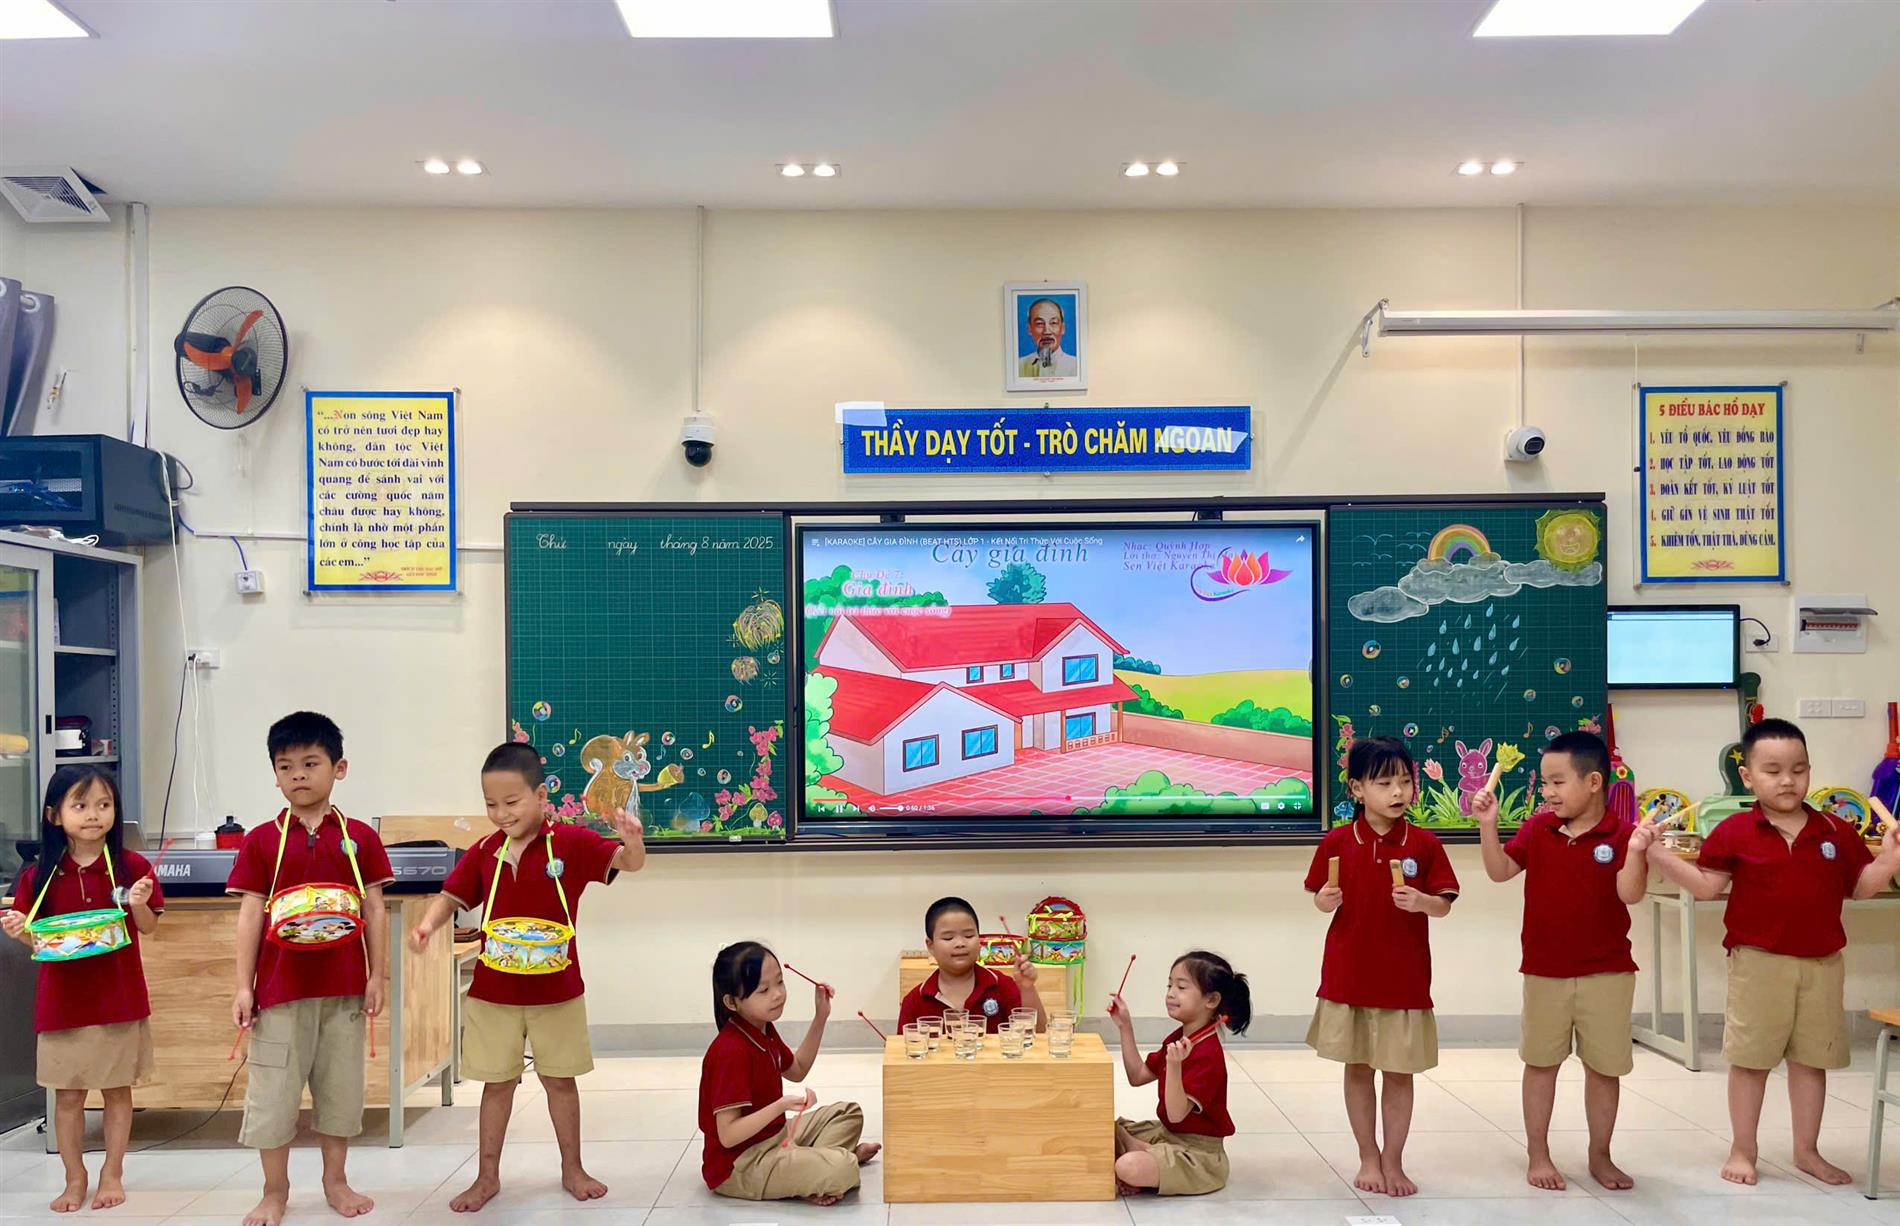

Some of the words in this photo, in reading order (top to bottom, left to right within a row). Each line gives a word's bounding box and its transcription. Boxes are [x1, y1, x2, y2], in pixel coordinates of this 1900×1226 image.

[1659, 404, 1665, 416] 5
[1669, 397, 1695, 416] ĐIỀU
[1698, 400, 1721, 416] BÁC
[1723, 397, 1739, 415] HỒ
[1742, 403, 1765, 418] DẠY
[362, 411, 386, 421] sông
[391, 410, 412, 421] Việt
[418, 410, 443, 420] Nam
[318, 426, 330, 435] có
[333, 426, 350, 435] trở
[353, 426, 372, 435] nên
[377, 426, 397, 435] tươi
[401, 426, 421, 437] đẹp
[424, 426, 443, 437] hay
[861, 419, 918, 456] THẦY
[926, 430, 971, 463] DẠY
[976, 417, 1018, 456] TỐT
[1036, 422, 1078, 455] TRÒ
[1084, 421, 1147, 454] CHĂM
[1154, 426, 1232, 454] NGOAN
[365, 441, 385, 451] dân
[395, 442, 412, 453] tộc
[421, 441, 443, 452] Việt
[319, 457, 343, 467] Nam
[345, 457, 357, 467] có
[360, 457, 384, 468] bước
[386, 457, 400, 467] tới
[402, 457, 418, 467] đài
[421, 457, 444, 467] vinh
[1719, 457, 1733, 469] LAO
[319, 475, 352, 485] quang
[376, 474, 400, 484] sánh
[407, 474, 422, 484] vai
[429, 474, 444, 484] với
[319, 490, 336, 499] các
[345, 490, 377, 501] cường
[386, 488, 412, 502] quốc
[421, 490, 444, 499] năm
[319, 507, 344, 516] châu
[351, 507, 377, 518] được
[383, 507, 401, 518] hay
[408, 506, 445, 517] không,
[1713, 508, 1730, 520] SINH
[319, 522, 349, 532] chính
[354, 522, 363, 532] là
[368, 522, 388, 532] nhờ
[393, 522, 413, 533] một
[418, 522, 445, 534] phần
[320, 539, 335, 548] lớn
[352, 538, 377, 549] công
[381, 539, 400, 550] học
[405, 538, 422, 550] tập
[426, 537, 445, 548] của
[607, 537, 638, 556] ngày
[660, 533, 698, 556] tháng
[701, 536, 709, 549] 8
[712, 538, 739, 549] năm
[743, 536, 774, 549] 2025
[320, 556, 338, 566] các
[153, 864, 190, 877] MAHA
